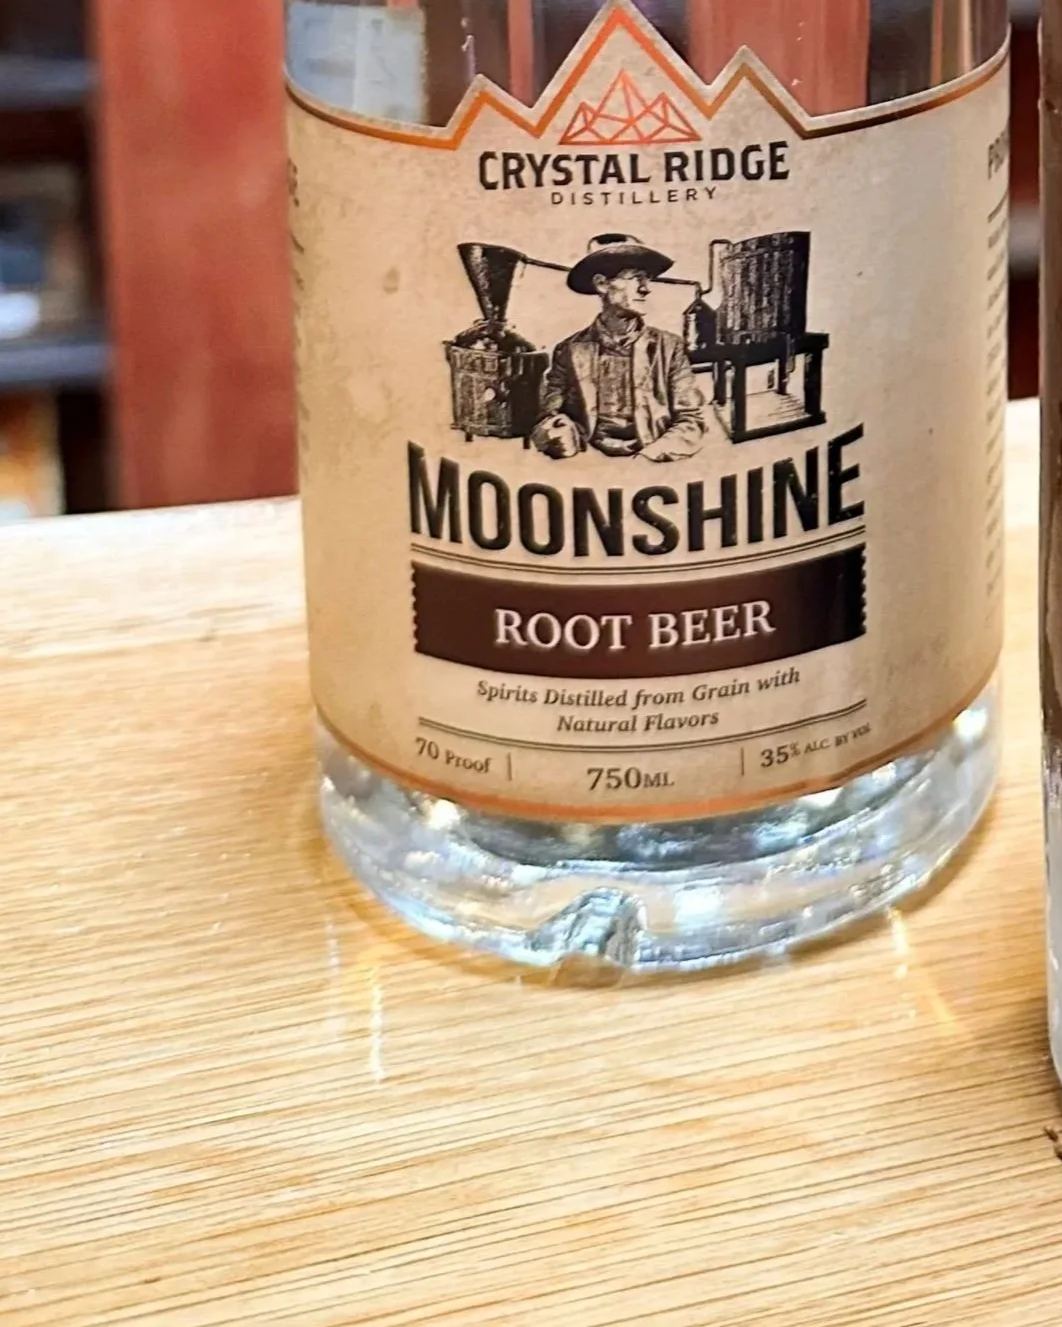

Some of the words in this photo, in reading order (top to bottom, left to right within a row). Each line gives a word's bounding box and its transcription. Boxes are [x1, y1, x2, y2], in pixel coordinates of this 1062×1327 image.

[478, 151, 651, 190] CRYSTAL
[664, 140, 791, 182] RIDGE
[551, 186, 718, 206] DISTILLERY
[407, 423, 865, 558] MOONSHINE
[494, 607, 633, 651] ROOT
[648, 599, 777, 650] BEER
[477, 679, 538, 704] Spirits
[544, 687, 628, 708] Distilled
[631, 688, 685, 711] from
[691, 681, 750, 702] Grain
[757, 666, 801, 692] with
[556, 714, 638, 733] Natural
[643, 710, 720, 733] Flavors
[415, 736, 440, 761] 70
[445, 748, 493, 774] Proof
